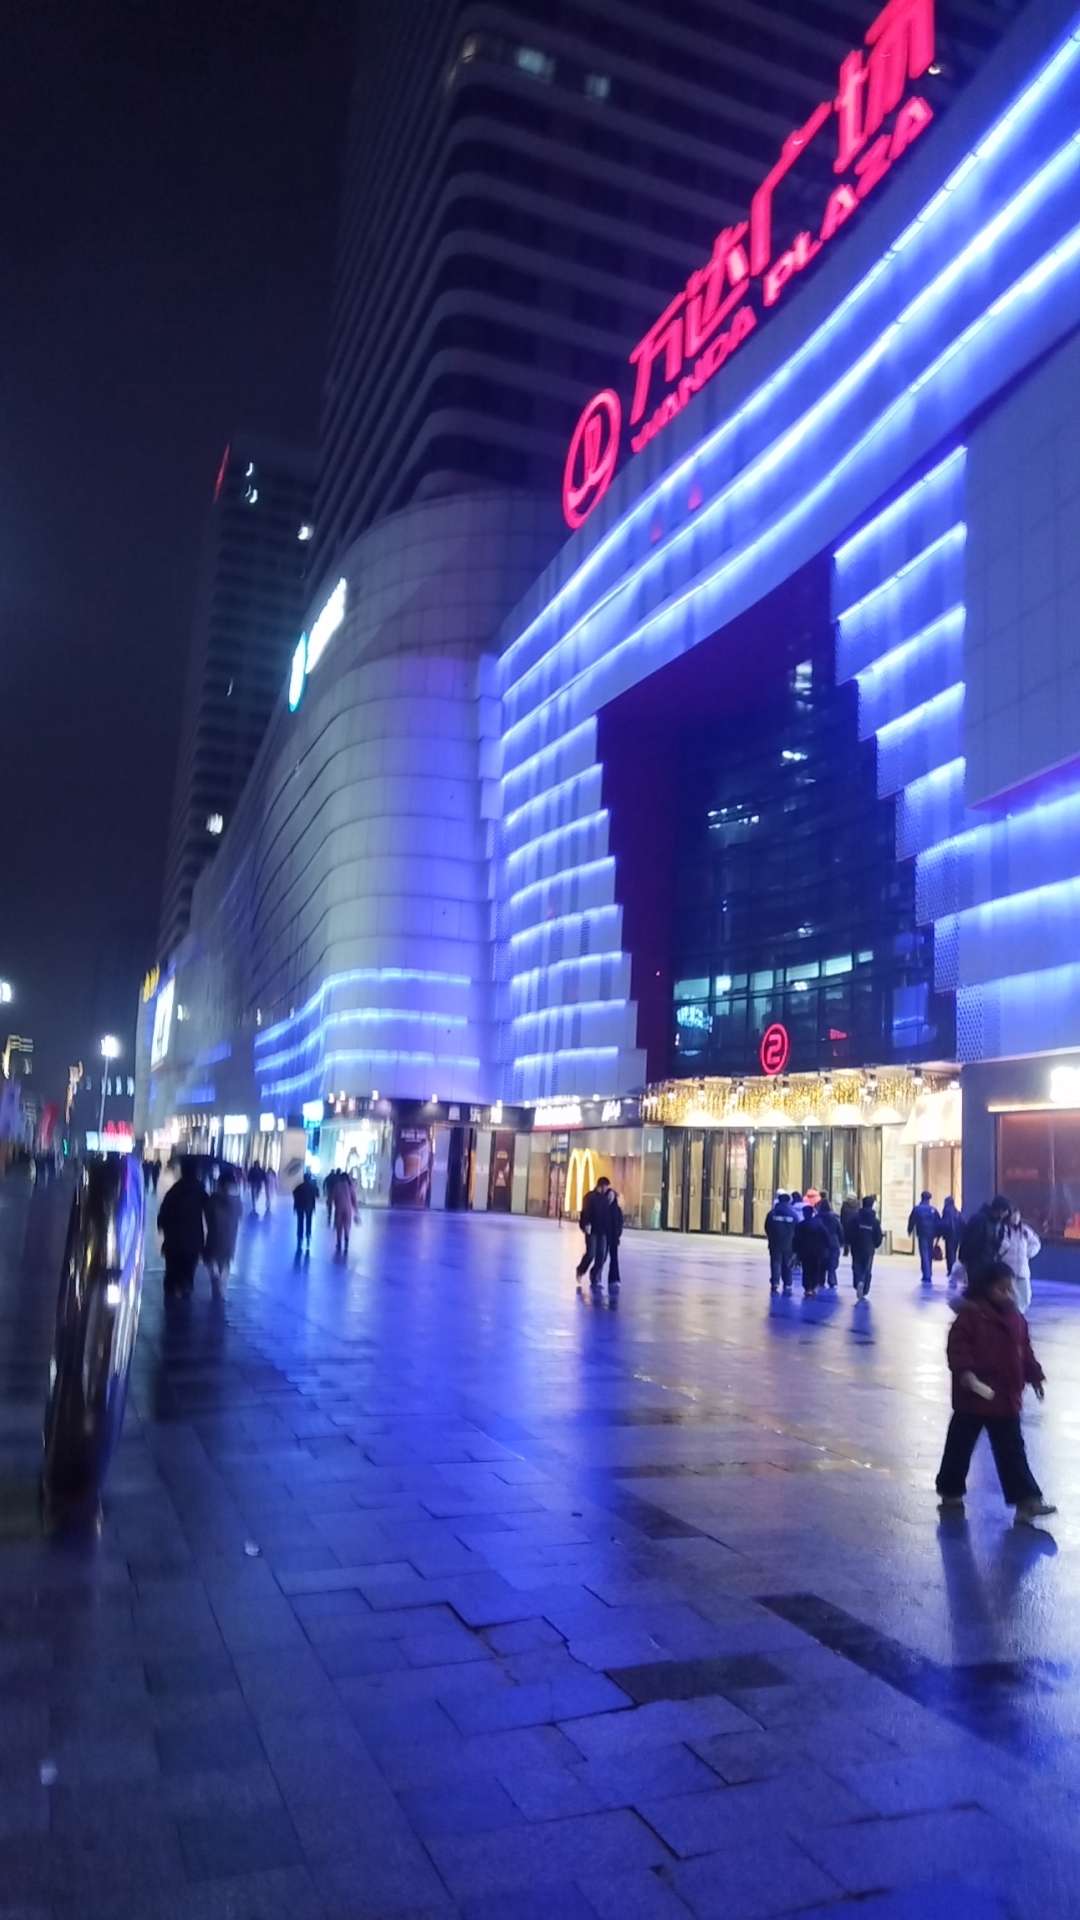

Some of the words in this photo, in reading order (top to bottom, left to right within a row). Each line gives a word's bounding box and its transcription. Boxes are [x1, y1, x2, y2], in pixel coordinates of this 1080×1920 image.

[629, 0, 935, 426] 万达广场
[631, 306, 757, 454] WANDA
[763, 96, 935, 308] PLAZA
